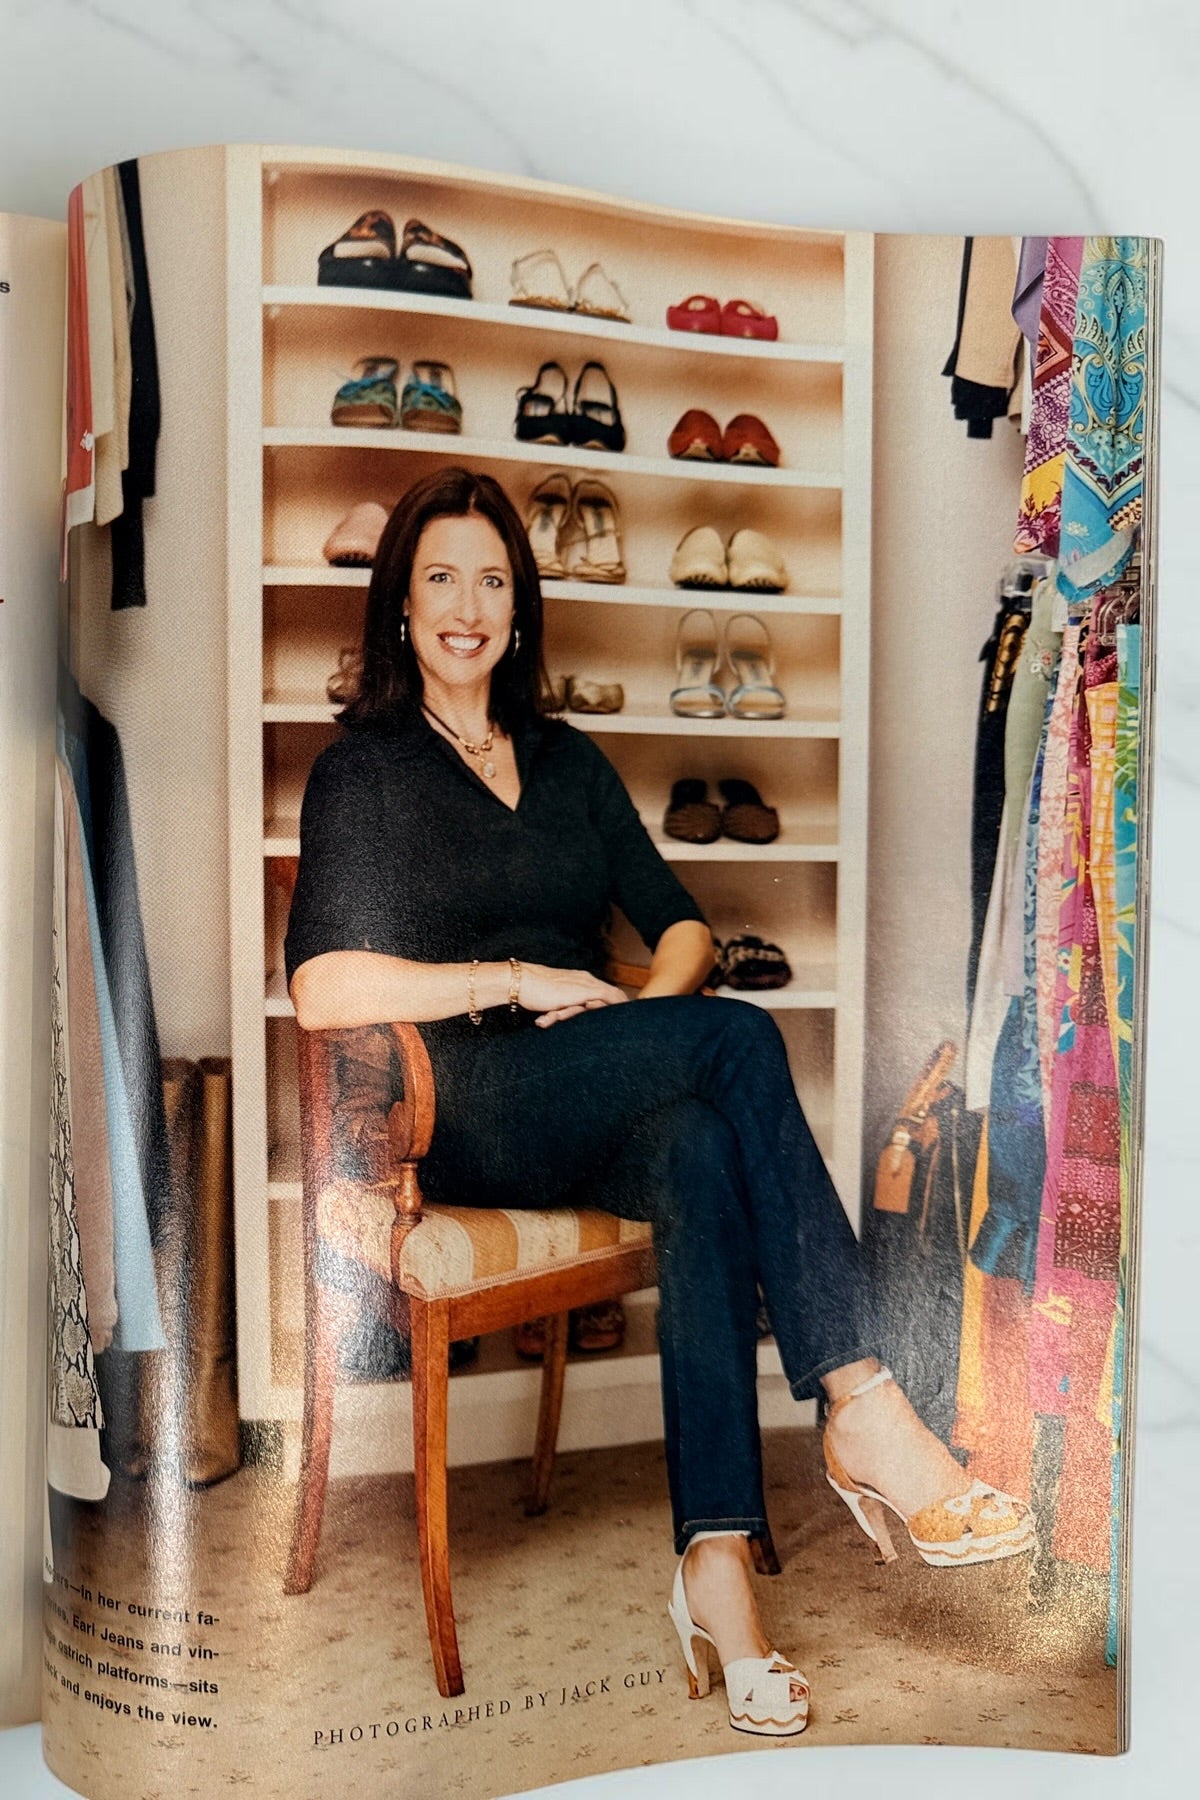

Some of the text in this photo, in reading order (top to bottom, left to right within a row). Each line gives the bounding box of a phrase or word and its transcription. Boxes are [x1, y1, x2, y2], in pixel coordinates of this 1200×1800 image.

[97, 1591, 121, 1611] her
[128, 1602, 190, 1623] current
[197, 1611, 220, 1626] fa-
[58, 1640, 93, 1669] ostrich
[72, 1614, 95, 1636] Earl
[100, 1628, 144, 1650] Jeans
[151, 1642, 182, 1657] and
[188, 1646, 219, 1660] vin-
[60, 1674, 80, 1696] and
[84, 1689, 131, 1715] enjoys
[137, 1705, 165, 1722] the
[171, 1711, 218, 1728] view.
[313, 1669, 667, 1745] PHOTOGRAPHED BY JACK GUY
